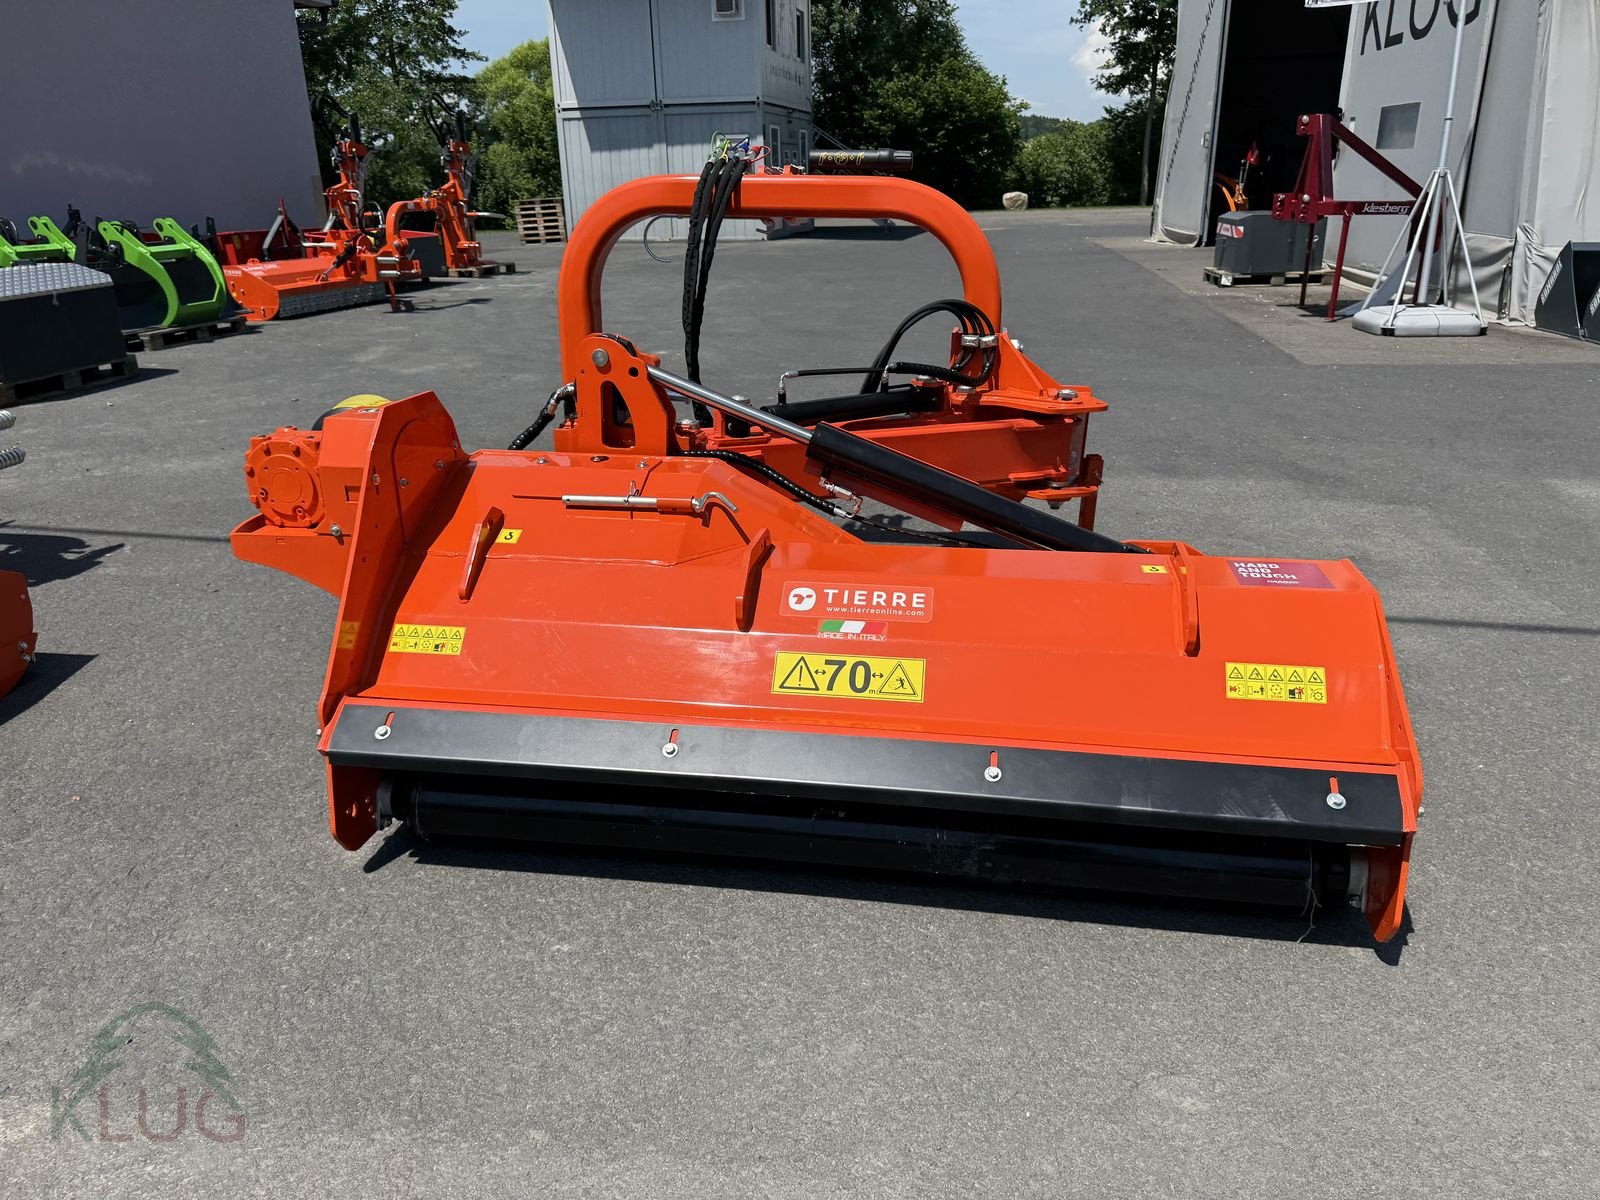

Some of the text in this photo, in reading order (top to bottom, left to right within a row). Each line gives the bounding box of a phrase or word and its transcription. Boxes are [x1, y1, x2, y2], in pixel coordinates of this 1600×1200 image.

[1239, 572, 1297, 580] TOUGH
[823, 589, 926, 608] TIERRE
[826, 605, 925, 616] www.tierreonline.com
[817, 631, 845, 640] MADE
[859, 633, 886, 641] ITALY
[824, 659, 872, 694] 70
